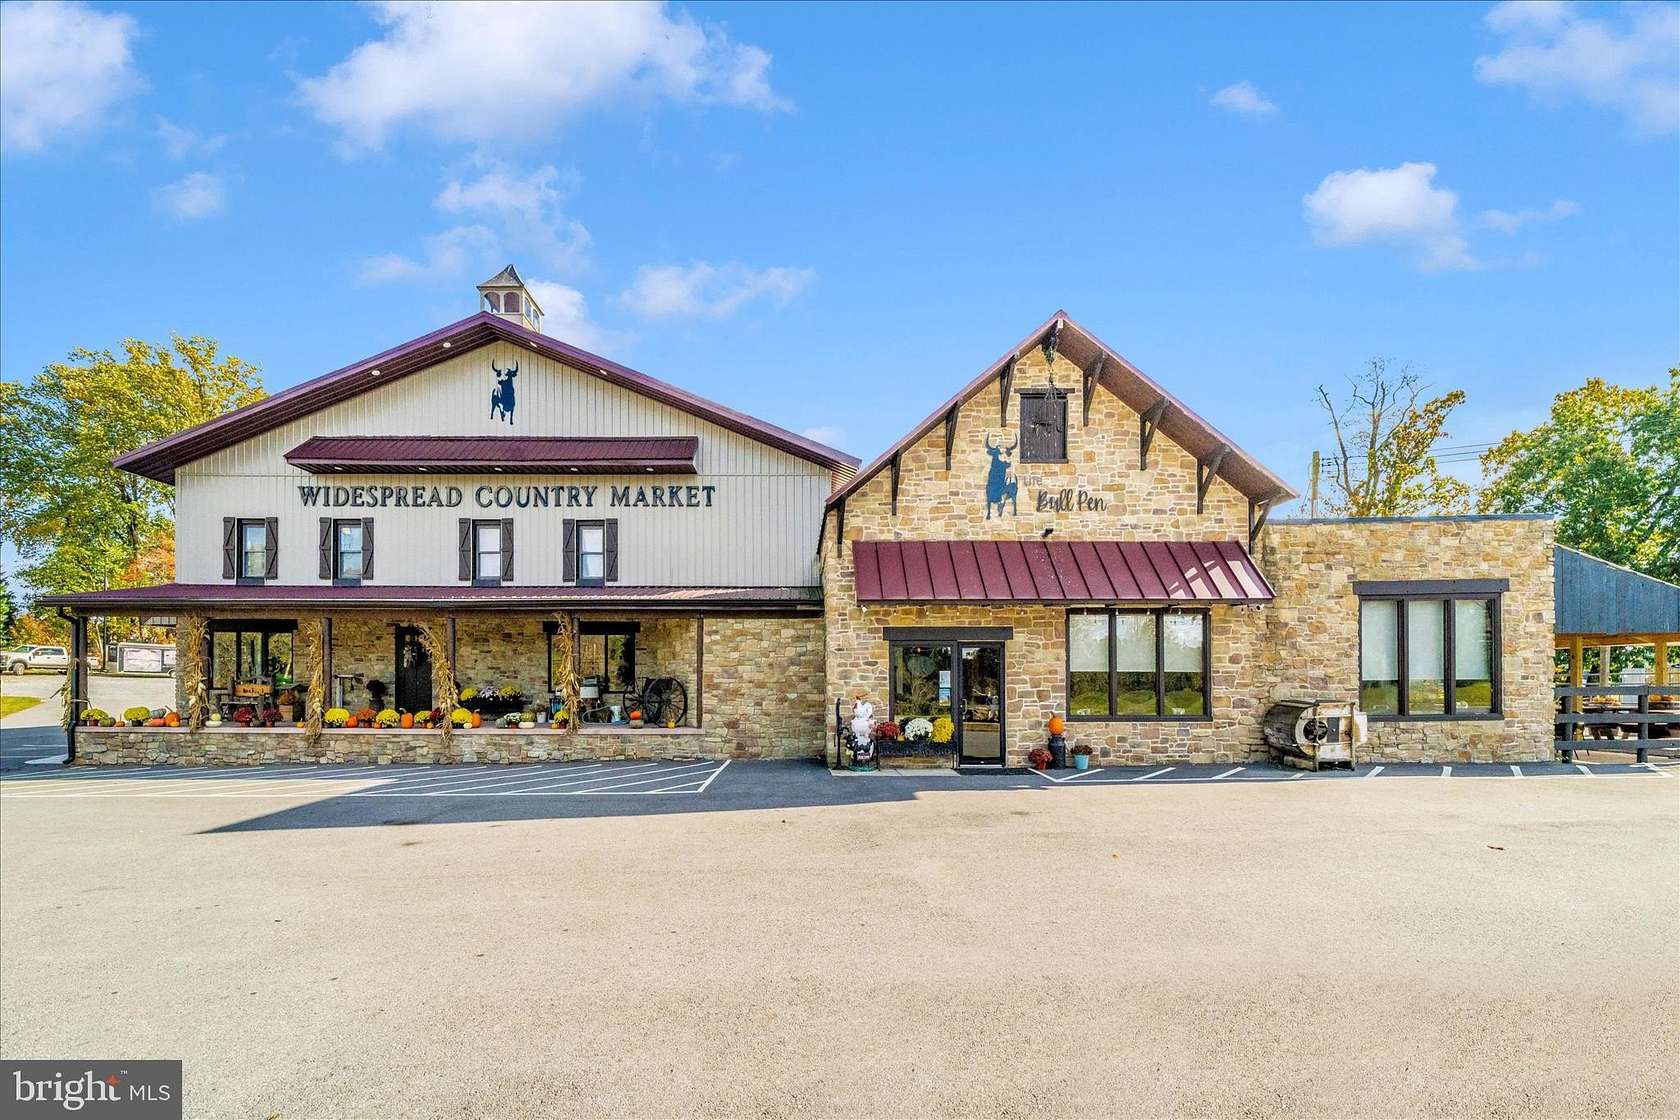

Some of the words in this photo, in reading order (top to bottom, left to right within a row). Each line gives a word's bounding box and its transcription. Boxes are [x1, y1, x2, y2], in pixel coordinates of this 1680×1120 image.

[297, 485, 463, 508] WIDESPREAD
[474, 485, 598, 508] COUNTRY
[610, 485, 716, 508] MARKET
[1036, 488, 1074, 512] Bull
[1077, 489, 1107, 512] Pen
